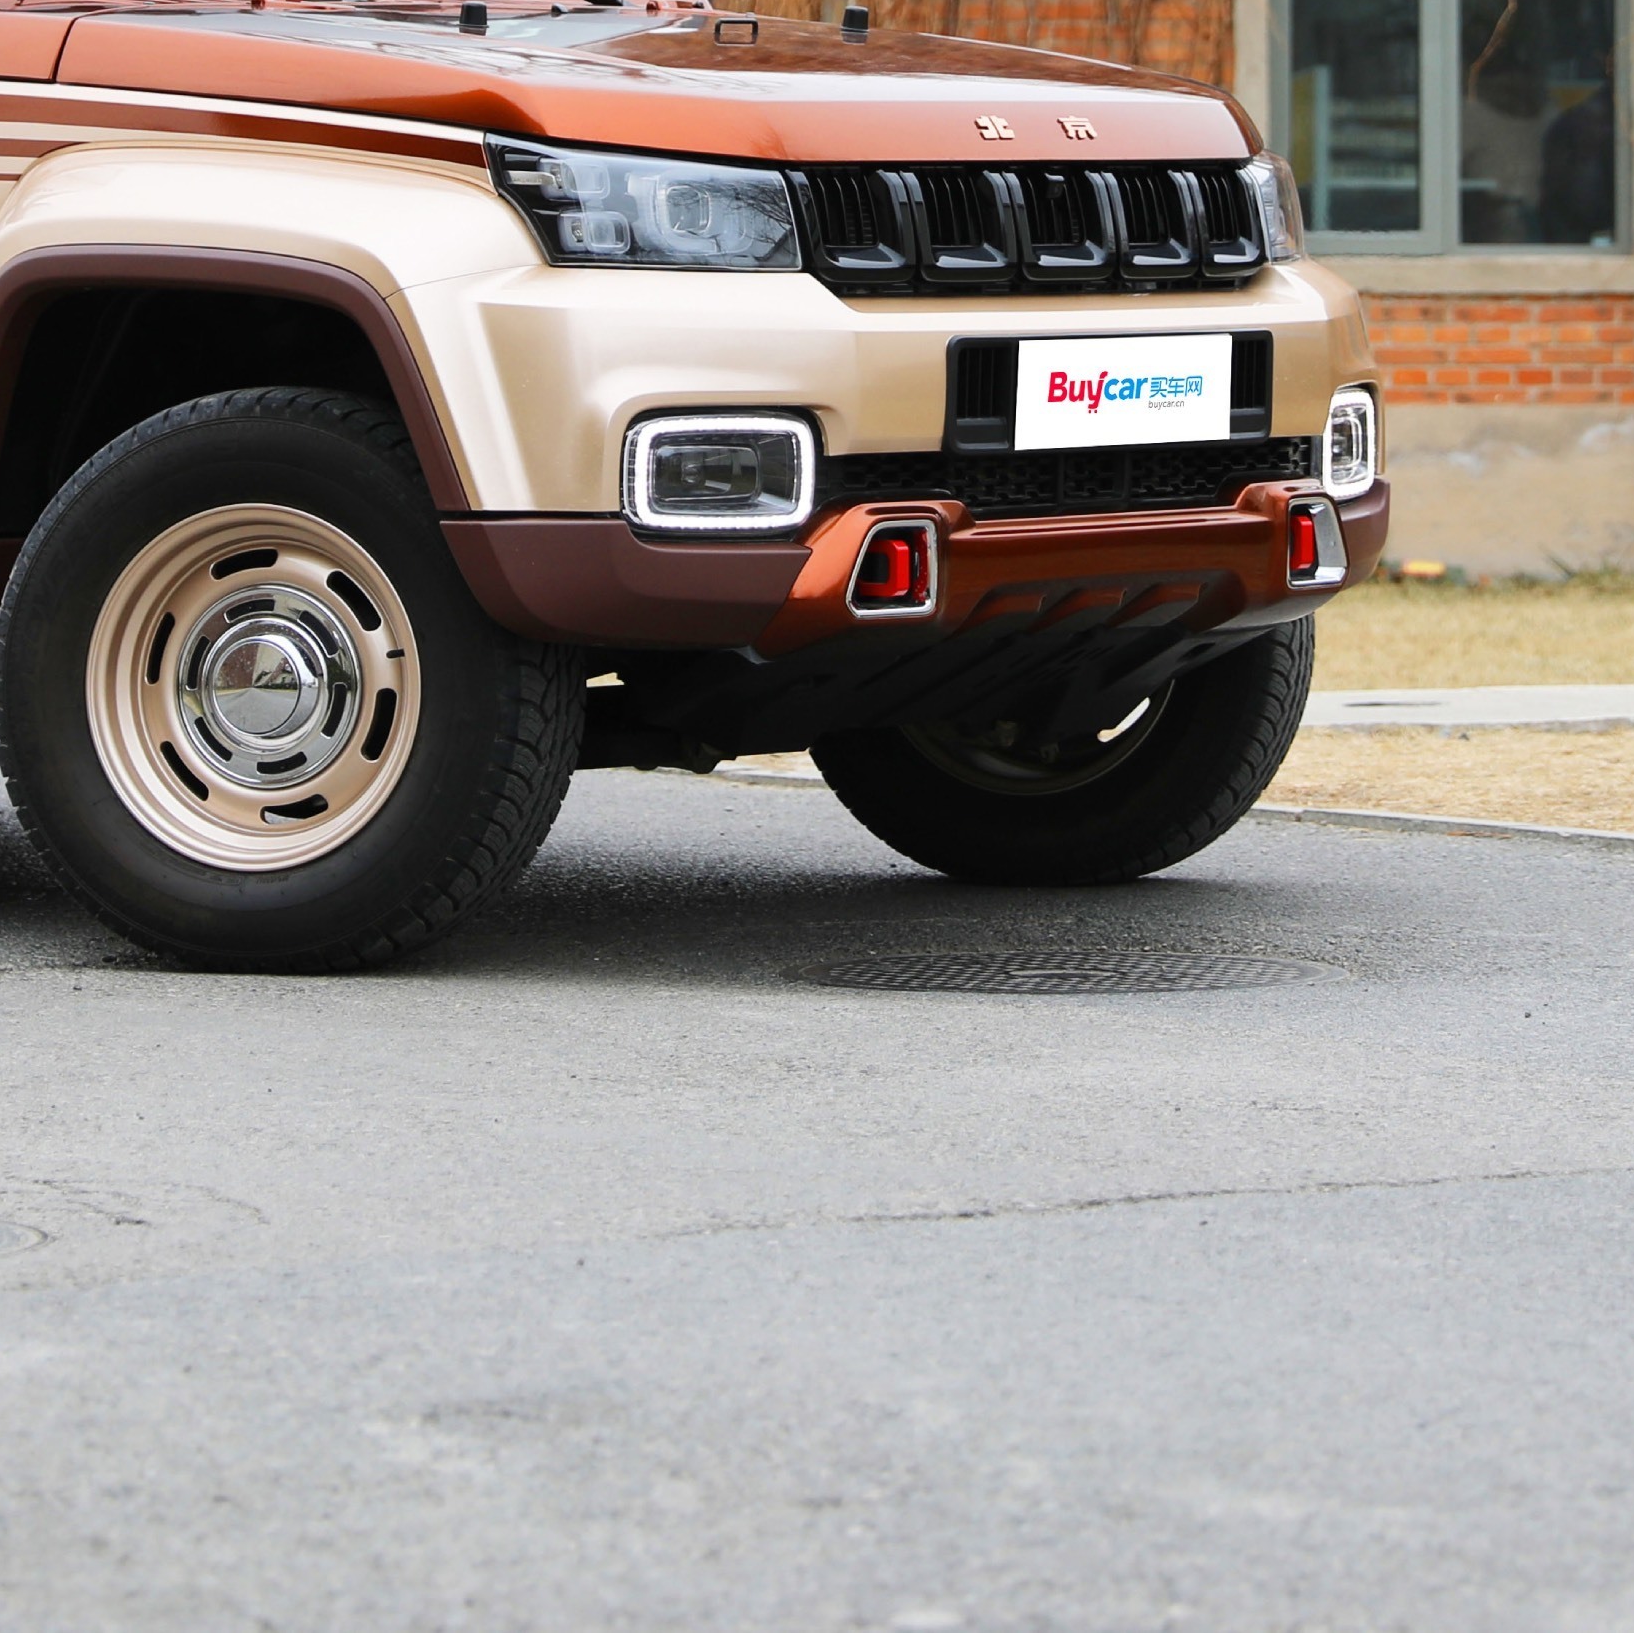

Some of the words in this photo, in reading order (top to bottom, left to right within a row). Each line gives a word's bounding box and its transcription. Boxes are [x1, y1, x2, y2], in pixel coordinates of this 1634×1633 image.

[974, 115, 1098, 140] 北京
[1048, 371, 1148, 413] Buycar
[1148, 375, 1203, 399] 买车网
[1148, 400, 1185, 411] buycar.cn
